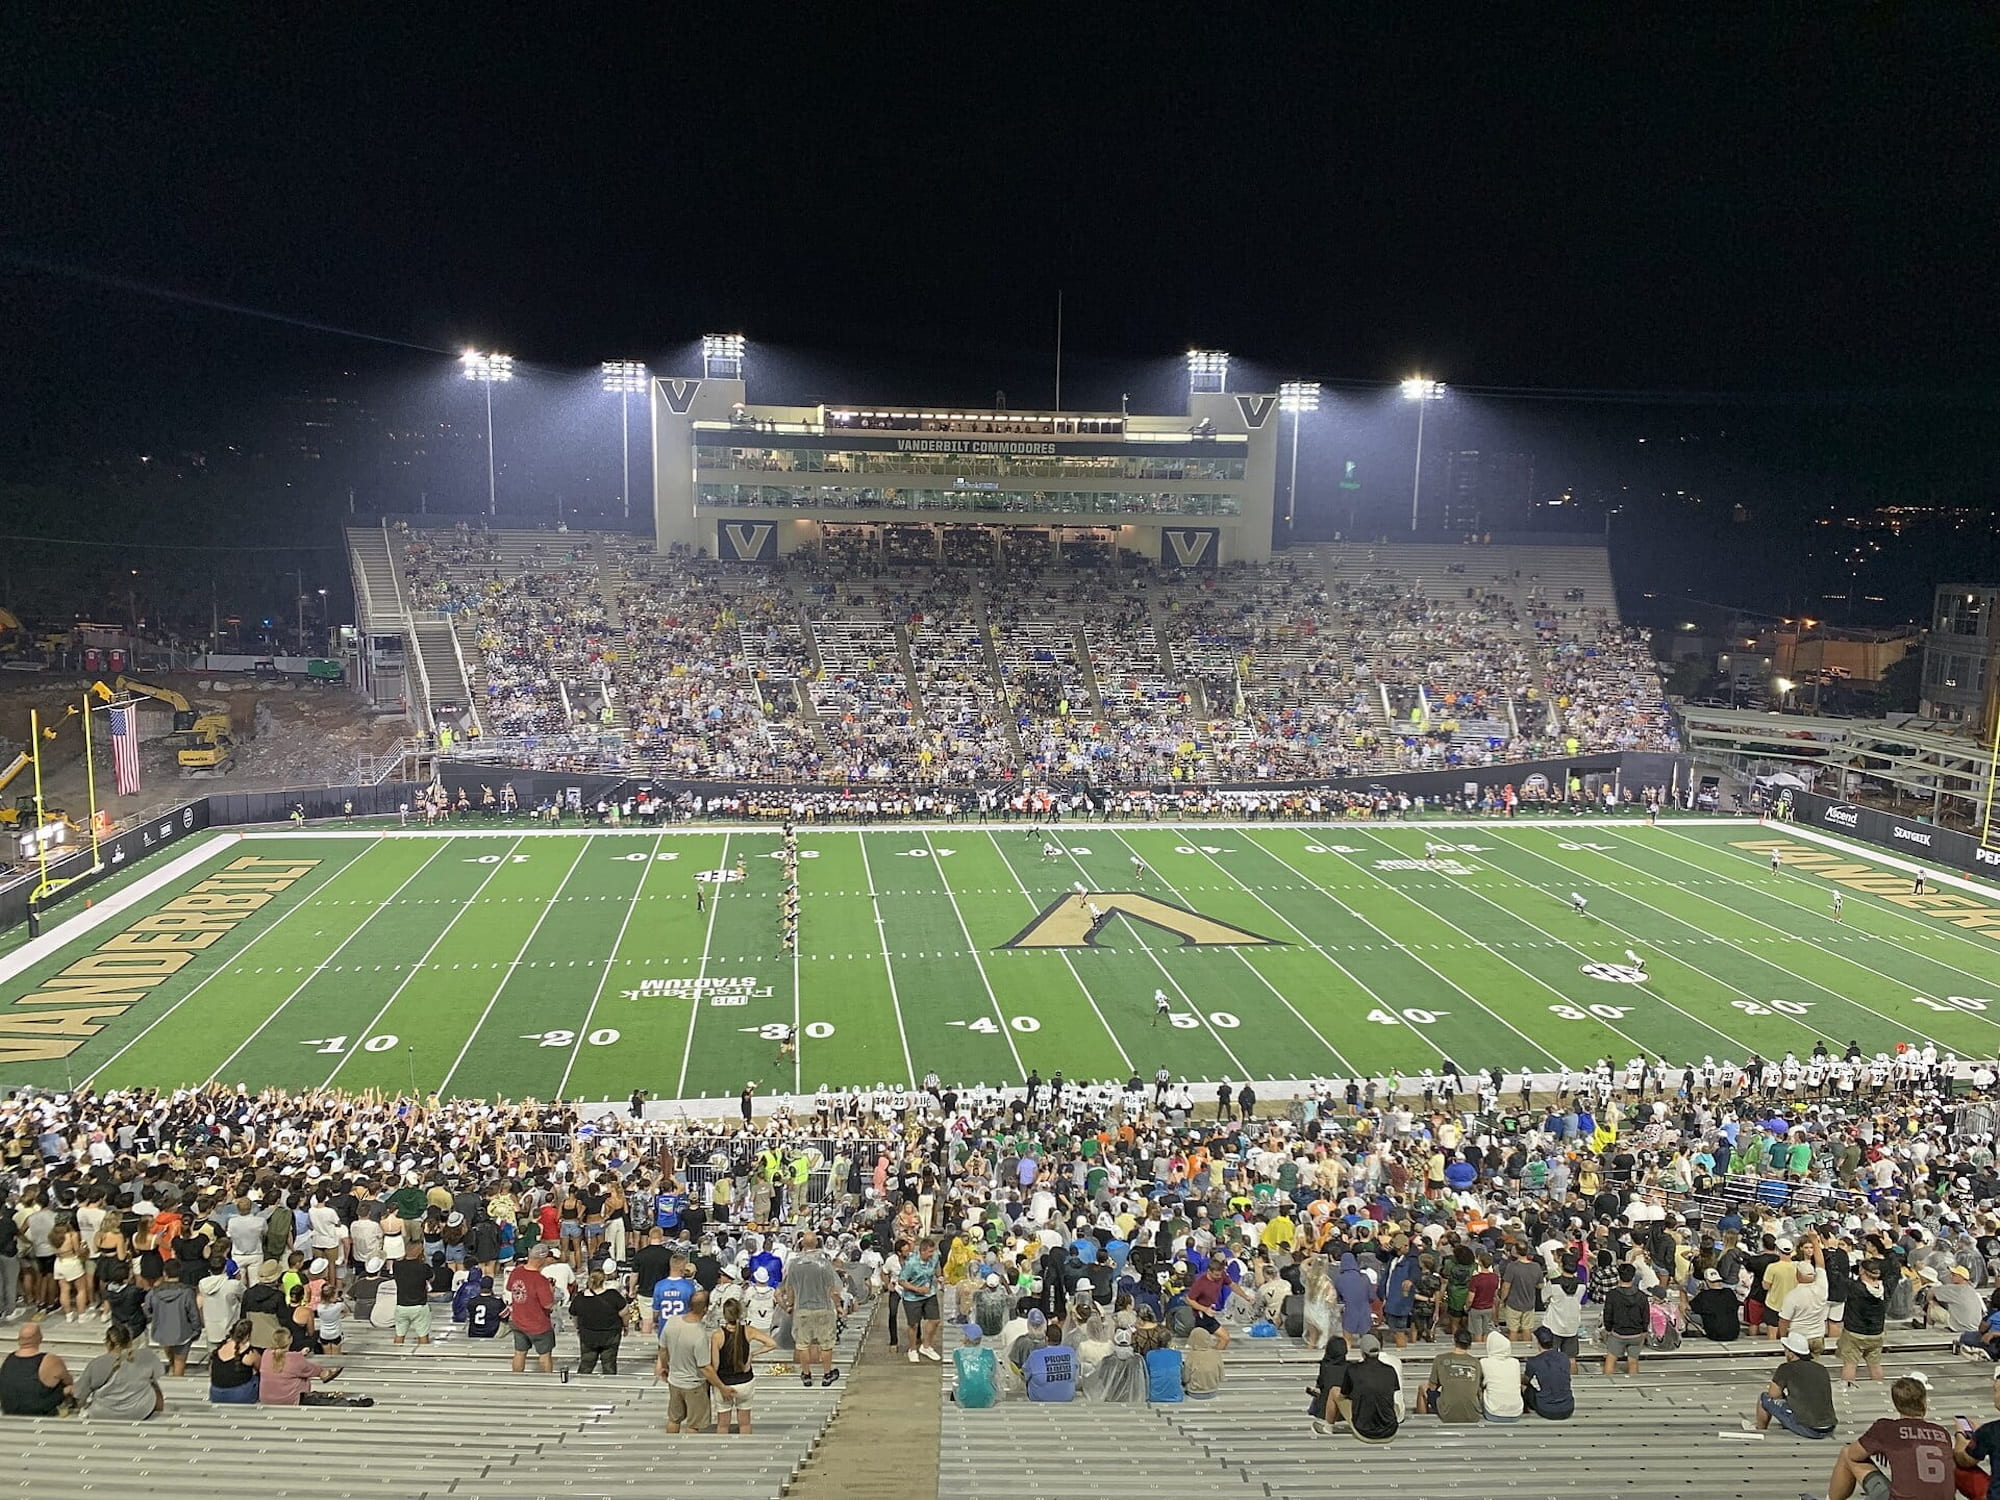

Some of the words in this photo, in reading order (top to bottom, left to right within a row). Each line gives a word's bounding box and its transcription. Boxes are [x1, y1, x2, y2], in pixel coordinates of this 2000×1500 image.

[657, 379, 702, 414] V
[1234, 396, 1278, 429] V
[898, 440, 970, 453] VANDERBILT
[972, 441, 1056, 454] COMMODORES
[725, 524, 773, 561] V
[1166, 531, 1213, 567] V
[1825, 806, 1858, 824] Ascend
[1894, 827, 1932, 847] SEATGEEK
[0, 856, 325, 1064] VANDERBILT
[620, 985, 775, 1001] FirstBank
[640, 977, 757, 990] STADIUM
[664, 1290, 681, 1298] HENRY
[474, 1304, 486, 1325] 2
[660, 1300, 685, 1319] 22
[1044, 1353, 1071, 1364] PROUD
[1046, 1372, 1071, 1382] DAD
[1899, 1426, 1948, 1443] SLATER
[1915, 1445, 1946, 1484] 6
